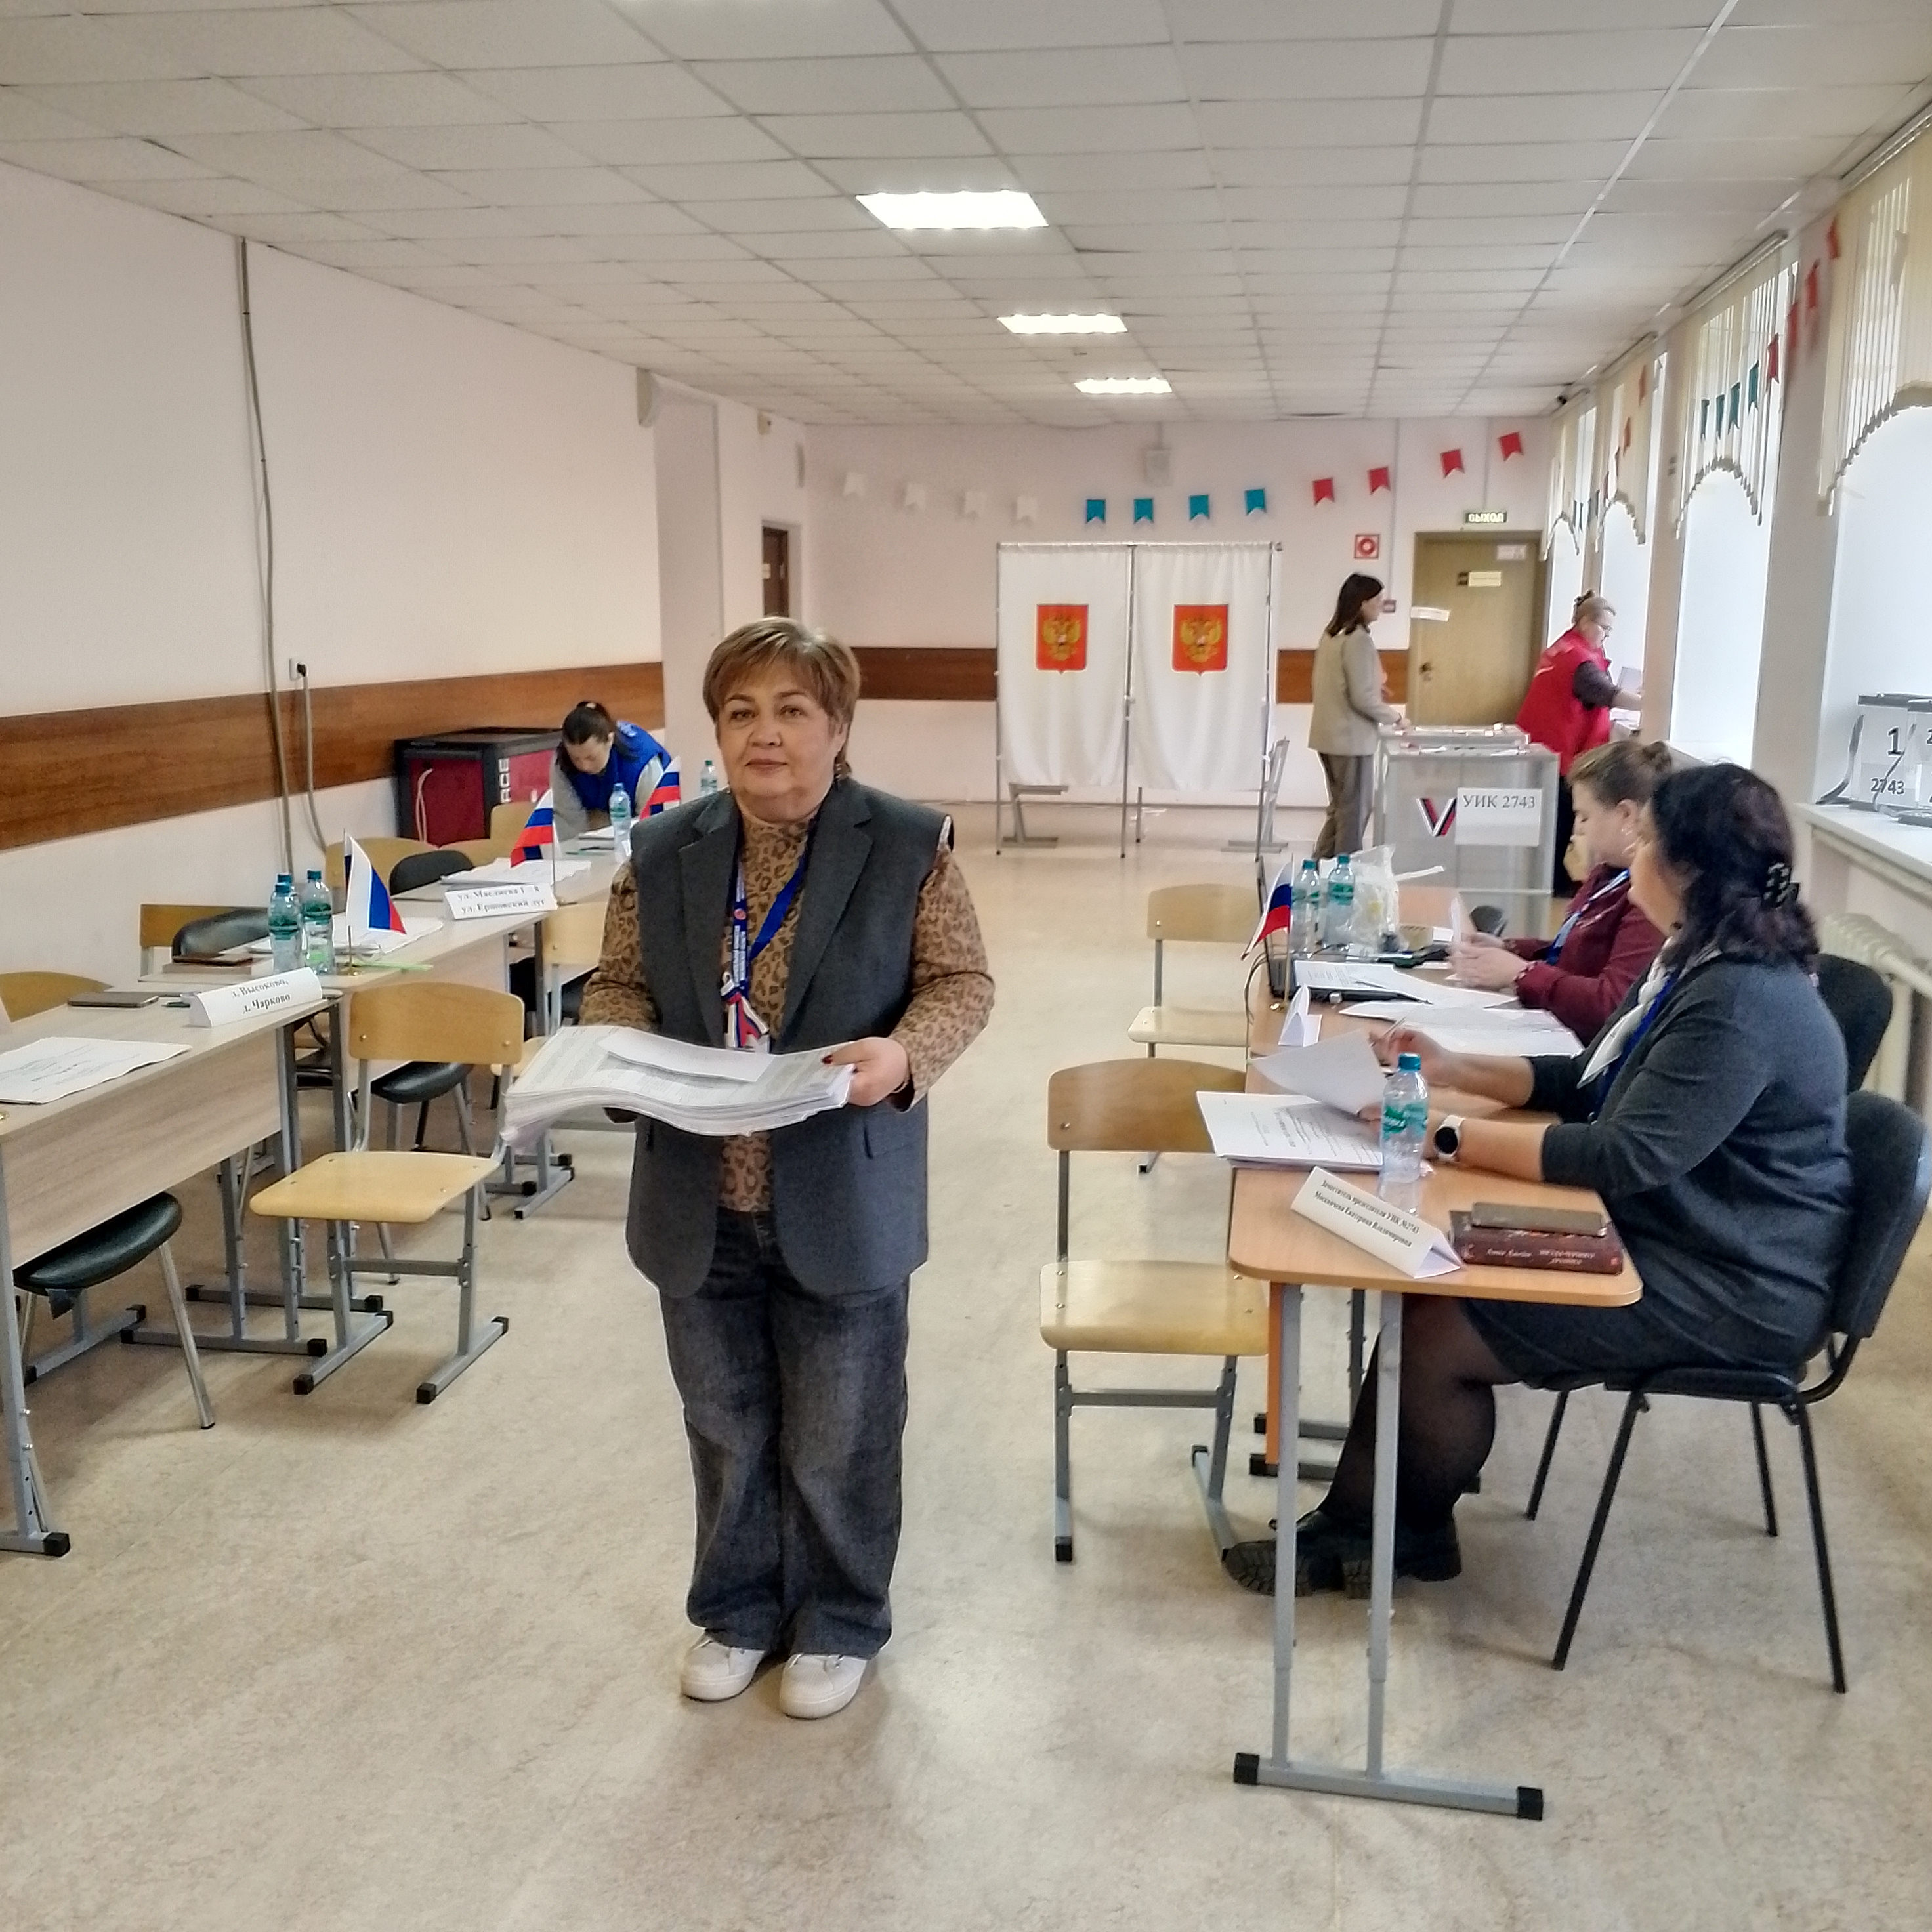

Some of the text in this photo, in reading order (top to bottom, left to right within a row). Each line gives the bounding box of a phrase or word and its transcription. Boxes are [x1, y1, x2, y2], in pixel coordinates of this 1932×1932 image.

[1887, 727, 1904, 755] 1
[1871, 778, 1904, 794] 2743
[1462, 795, 1536, 808] УИК 2743
[252, 994, 291, 1009] Чарково
[1321, 1179, 1352, 1201] Заместитель
[1352, 1195, 1387, 1219] председателя
